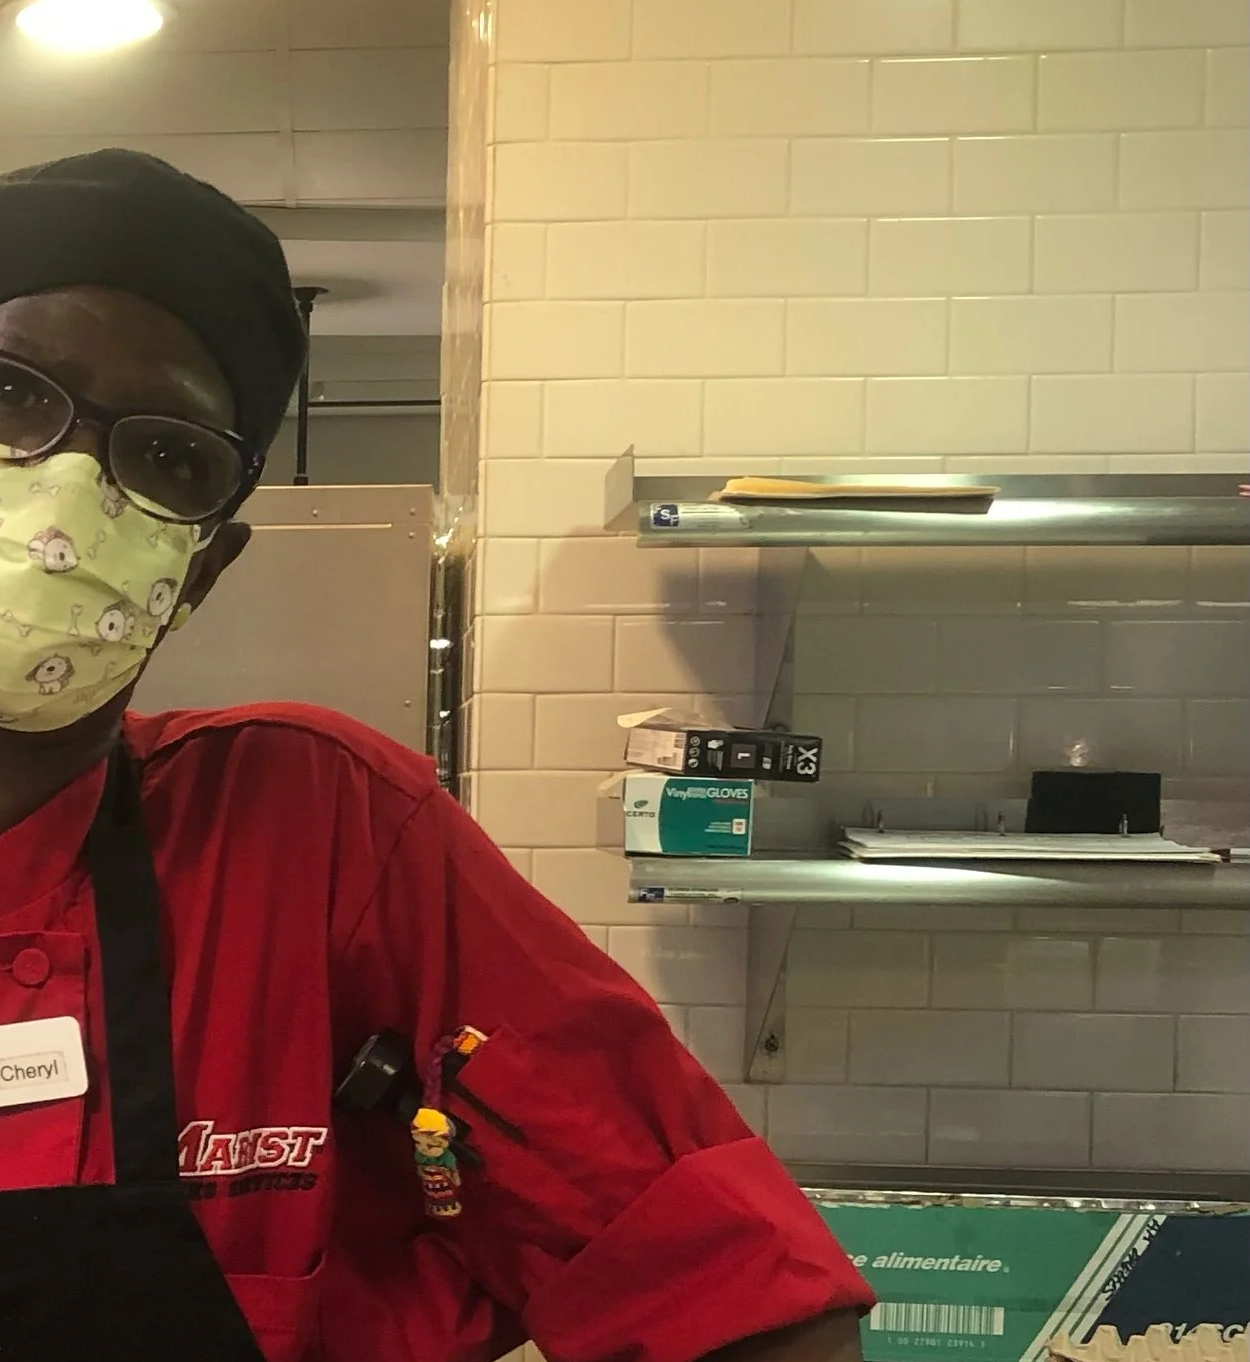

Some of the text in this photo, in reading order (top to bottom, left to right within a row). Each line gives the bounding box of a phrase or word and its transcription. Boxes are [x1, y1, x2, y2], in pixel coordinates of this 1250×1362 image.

[796, 746, 819, 776] X3
[706, 787, 749, 799] GLOVES
[0, 1059, 59, 1082] Cheryl
